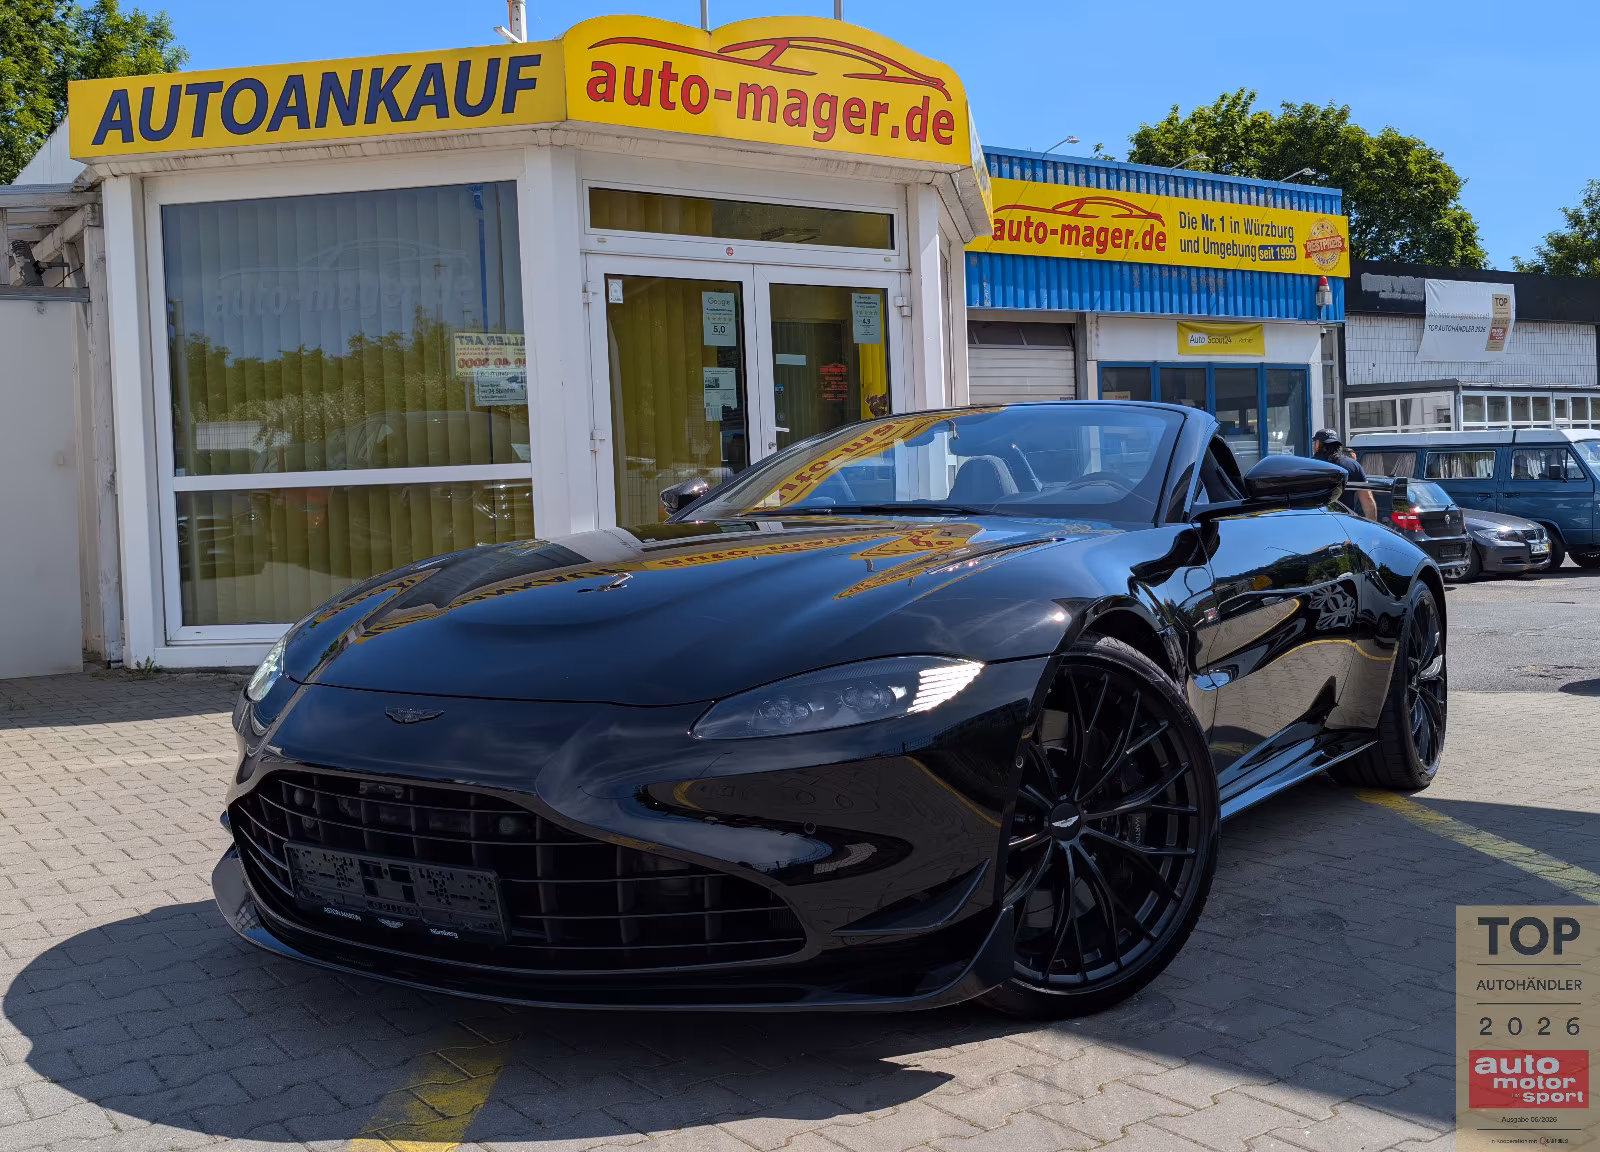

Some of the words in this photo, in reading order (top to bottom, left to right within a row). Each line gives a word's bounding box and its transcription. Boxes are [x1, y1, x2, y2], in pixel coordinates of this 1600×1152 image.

[91, 54, 541, 146] AUTOANKAUF
[586, 60, 955, 146] auto-mager.de
[992, 216, 1167, 255] auto-mager.de
[1179, 211, 1197, 230] Die
[1201, 213, 1217, 232] Nr.
[1220, 215, 1225, 232] 1
[1230, 216, 1240, 234] in
[1243, 217, 1294, 243] Würzburg
[1180, 236, 1200, 253] und
[1202, 236, 1256, 262] Umgebung
[1259, 246, 1275, 260] seit
[1276, 246, 1295, 260] 1999
[1494, 297, 1508, 307] TOP
[713, 325, 726, 333] 5,0
